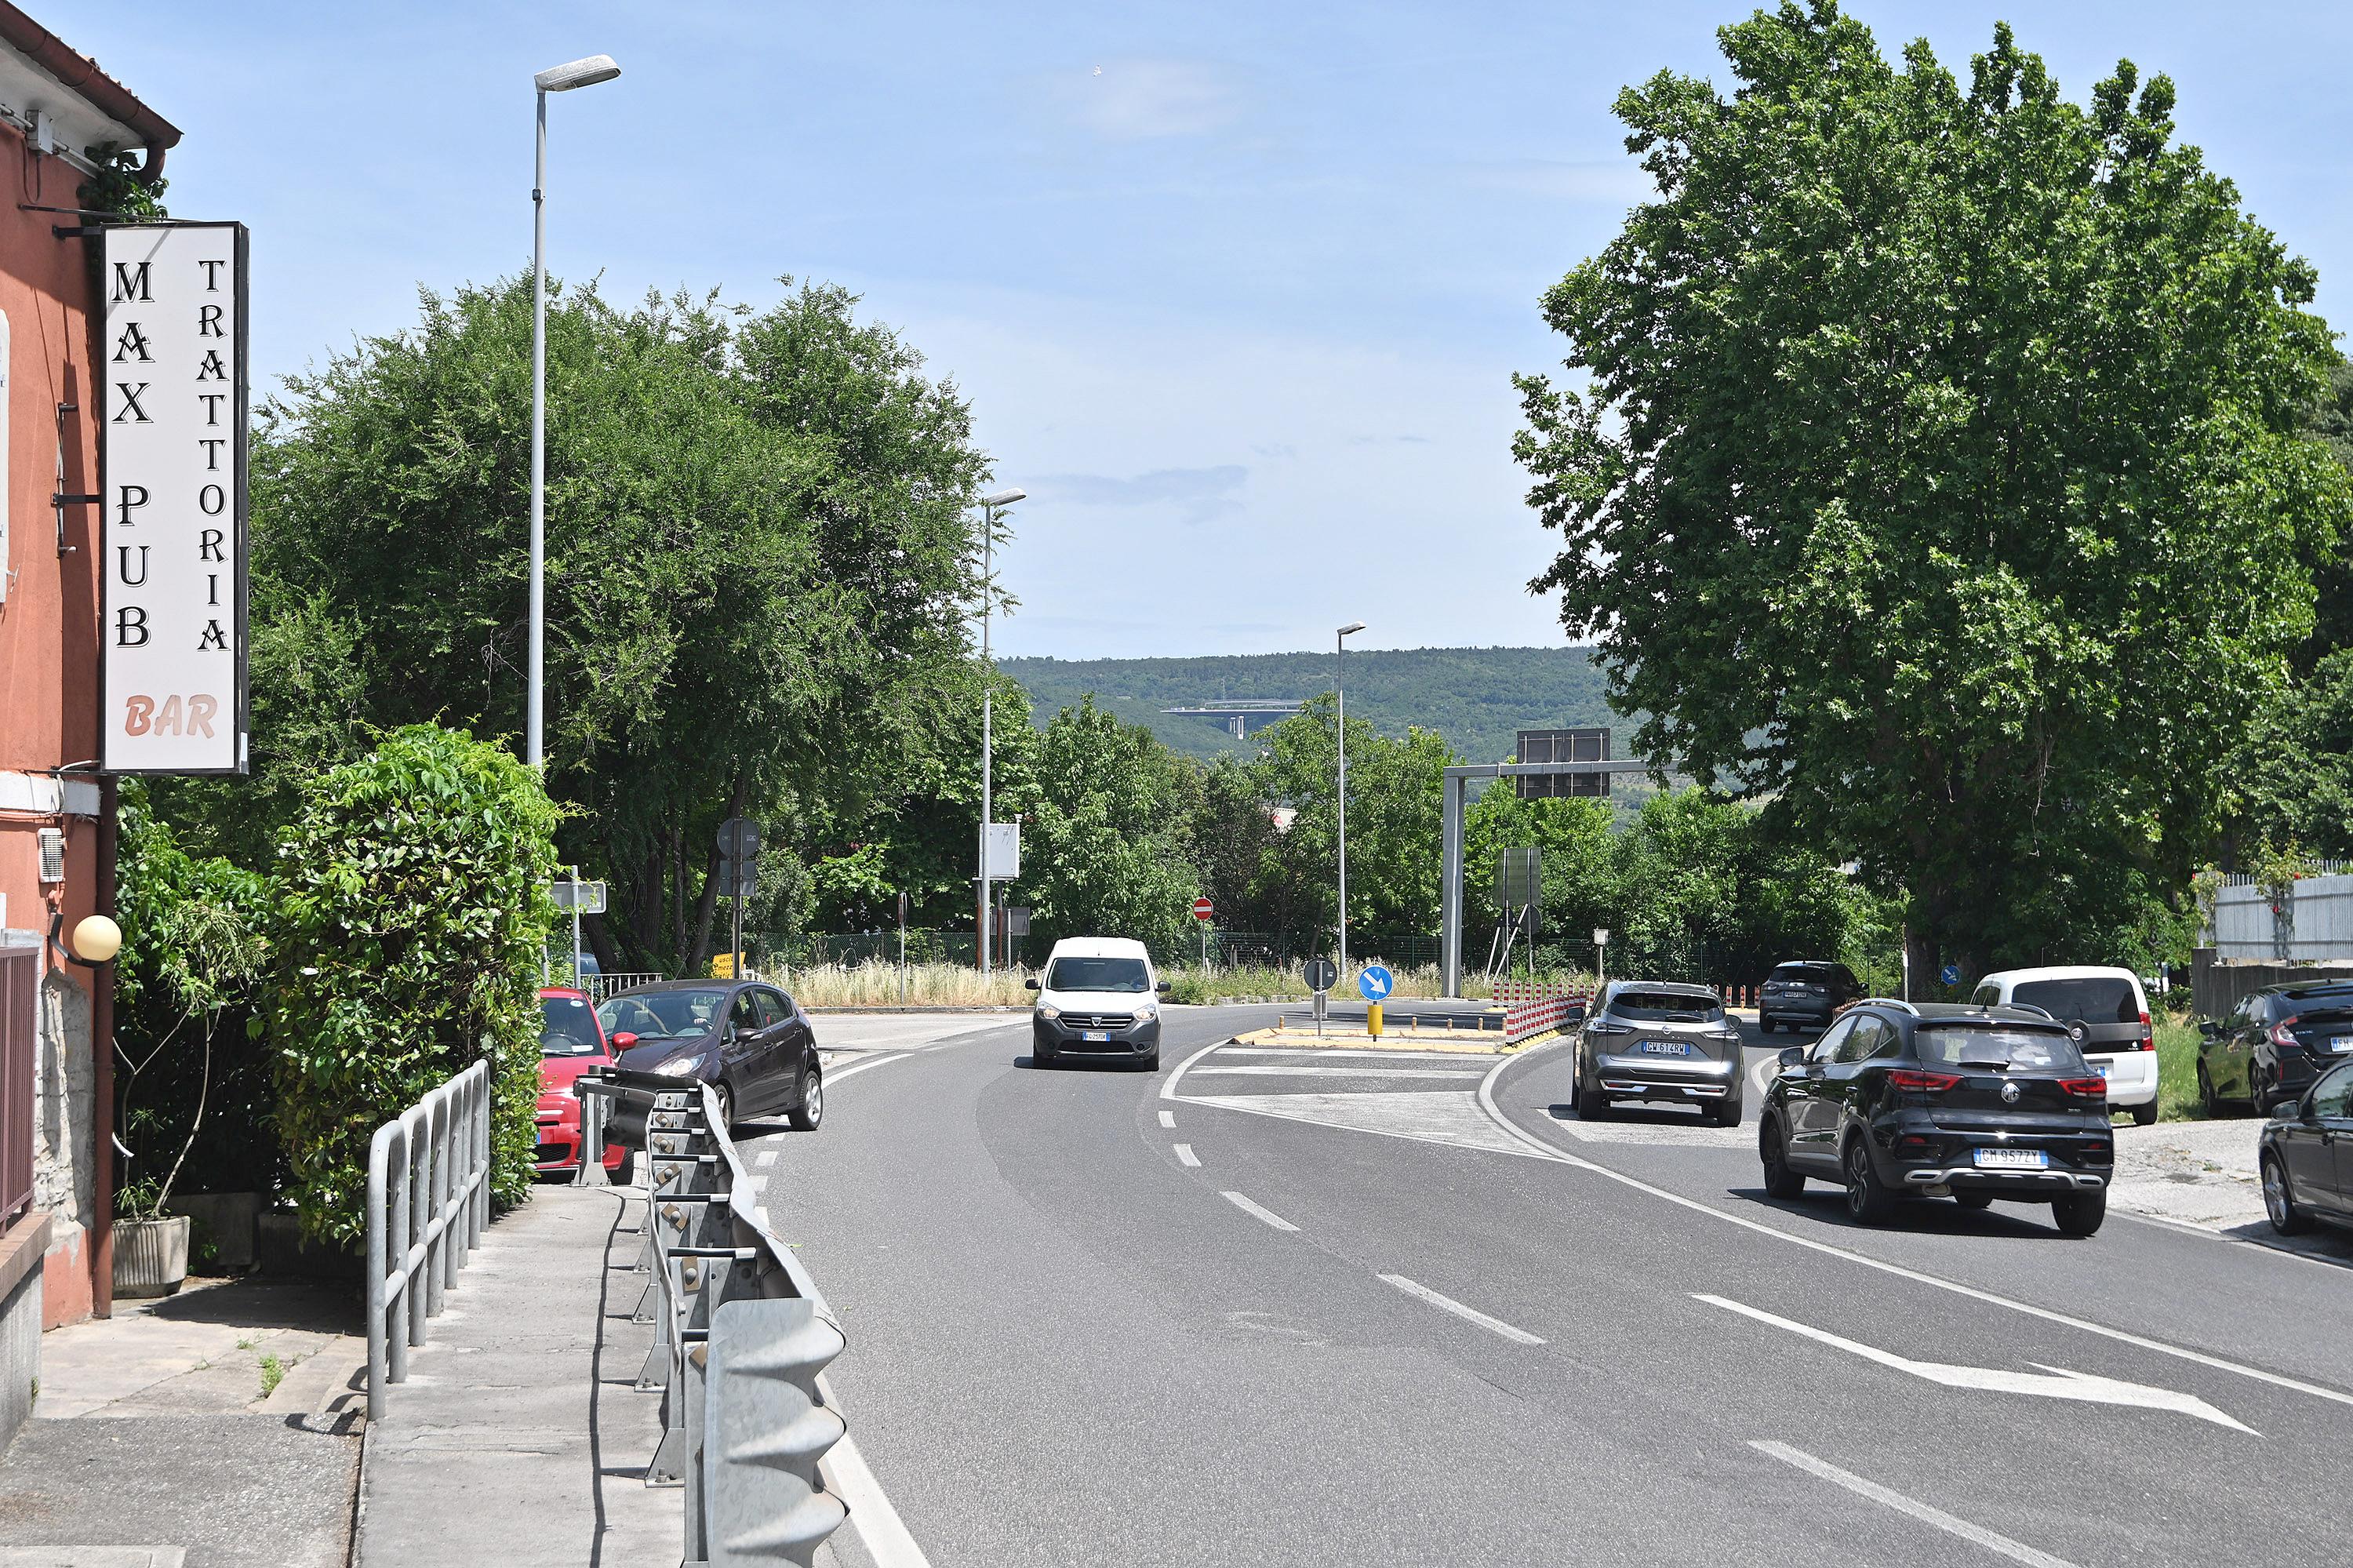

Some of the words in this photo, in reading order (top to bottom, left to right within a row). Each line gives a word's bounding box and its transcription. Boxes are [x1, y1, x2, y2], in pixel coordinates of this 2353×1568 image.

[112, 260, 155, 424] MAX
[196, 260, 230, 652] TRATTORIA
[115, 486, 152, 649] PUB
[125, 694, 217, 739] BAR
[1648, 1042, 1657, 1051] GW
[1660, 1043, 1684, 1053] 614RW
[2001, 1150, 2038, 1163] 957ZY
